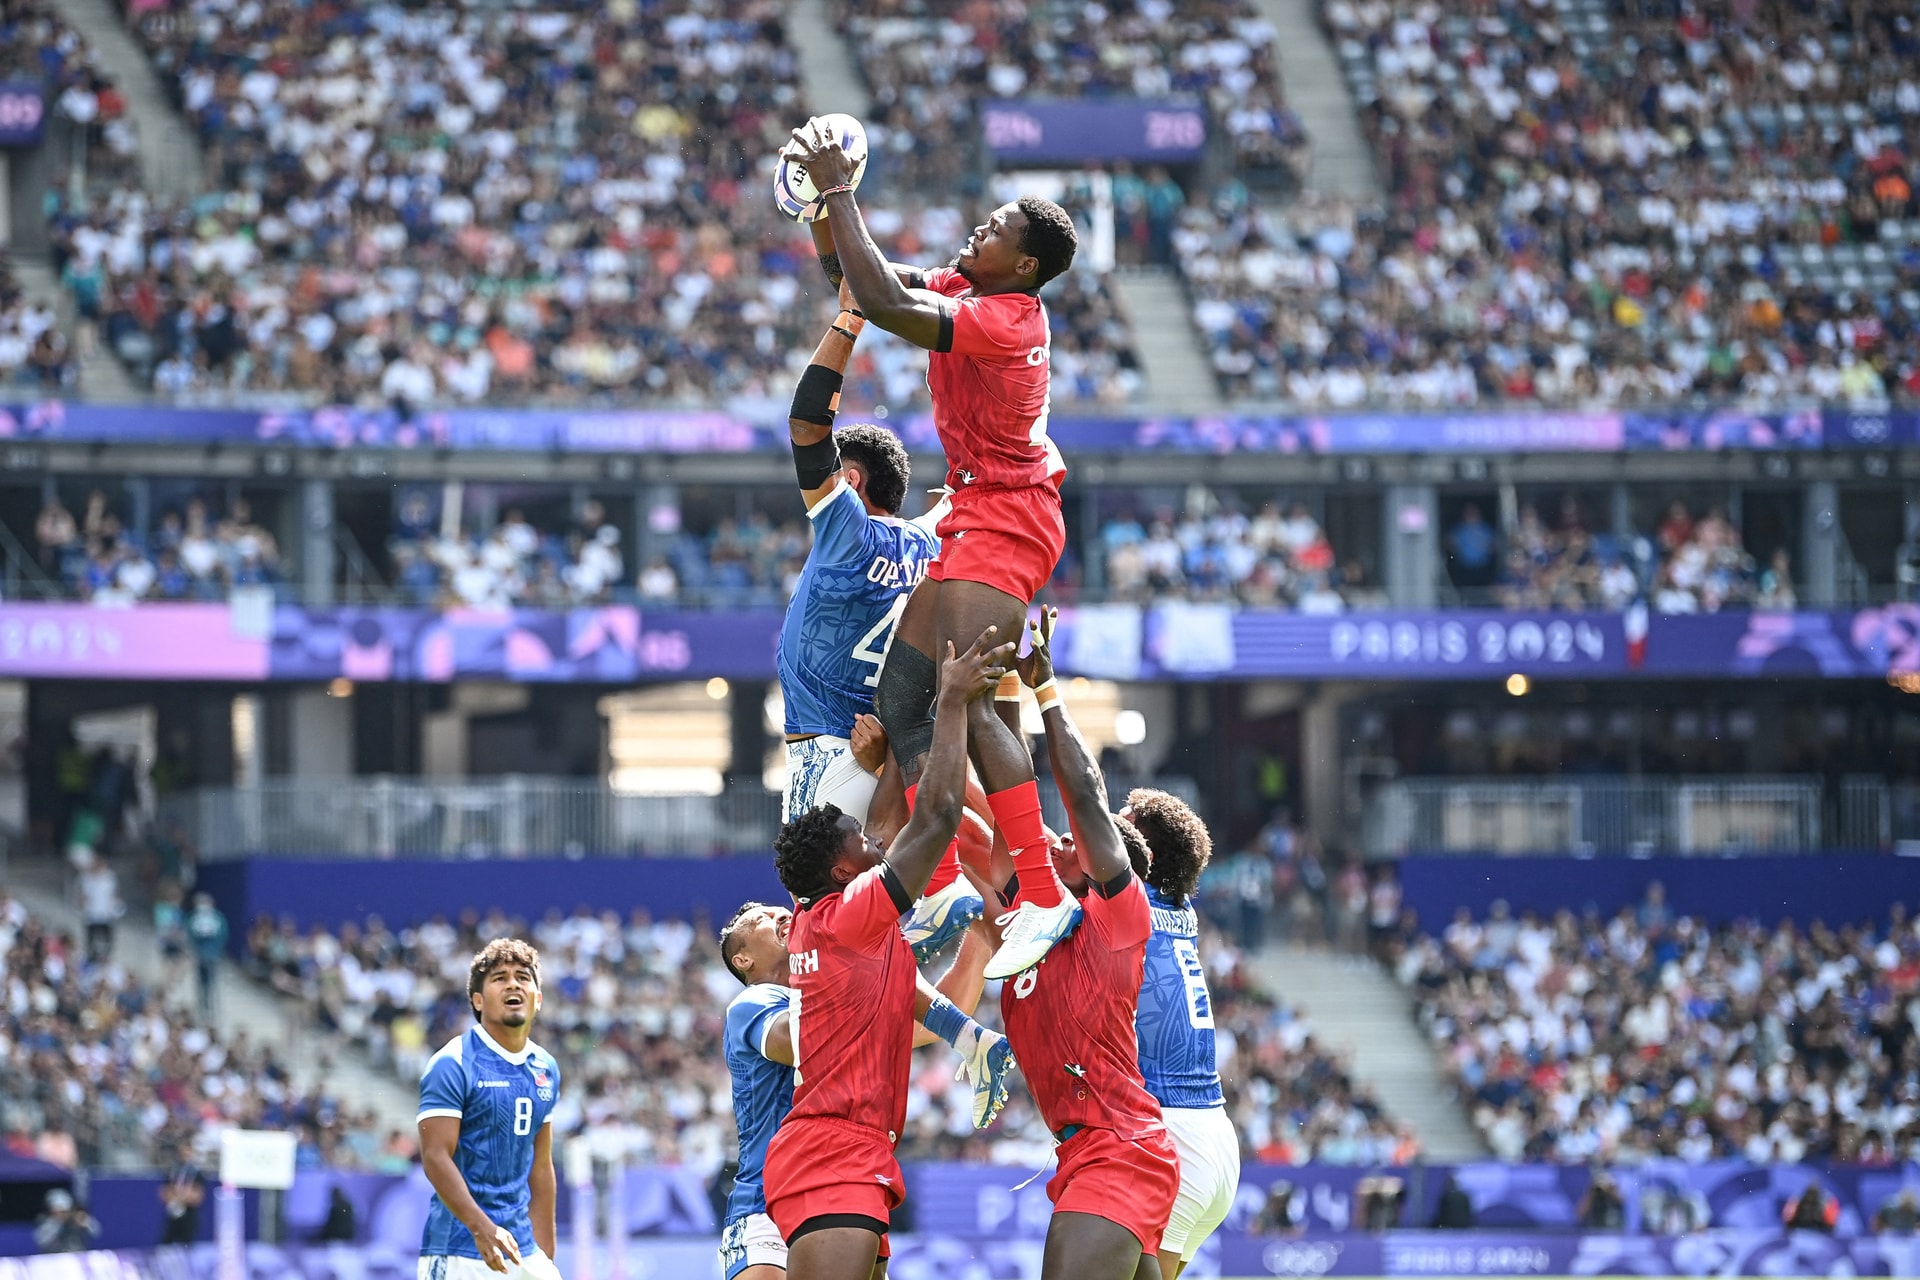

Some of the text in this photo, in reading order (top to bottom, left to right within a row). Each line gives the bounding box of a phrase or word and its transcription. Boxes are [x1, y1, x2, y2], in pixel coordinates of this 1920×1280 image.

[0, 617, 122, 662] 2024
[851, 592, 909, 688] 4
[1329, 619, 1604, 663] PARIS 2024
[513, 1096, 533, 1136] 8
